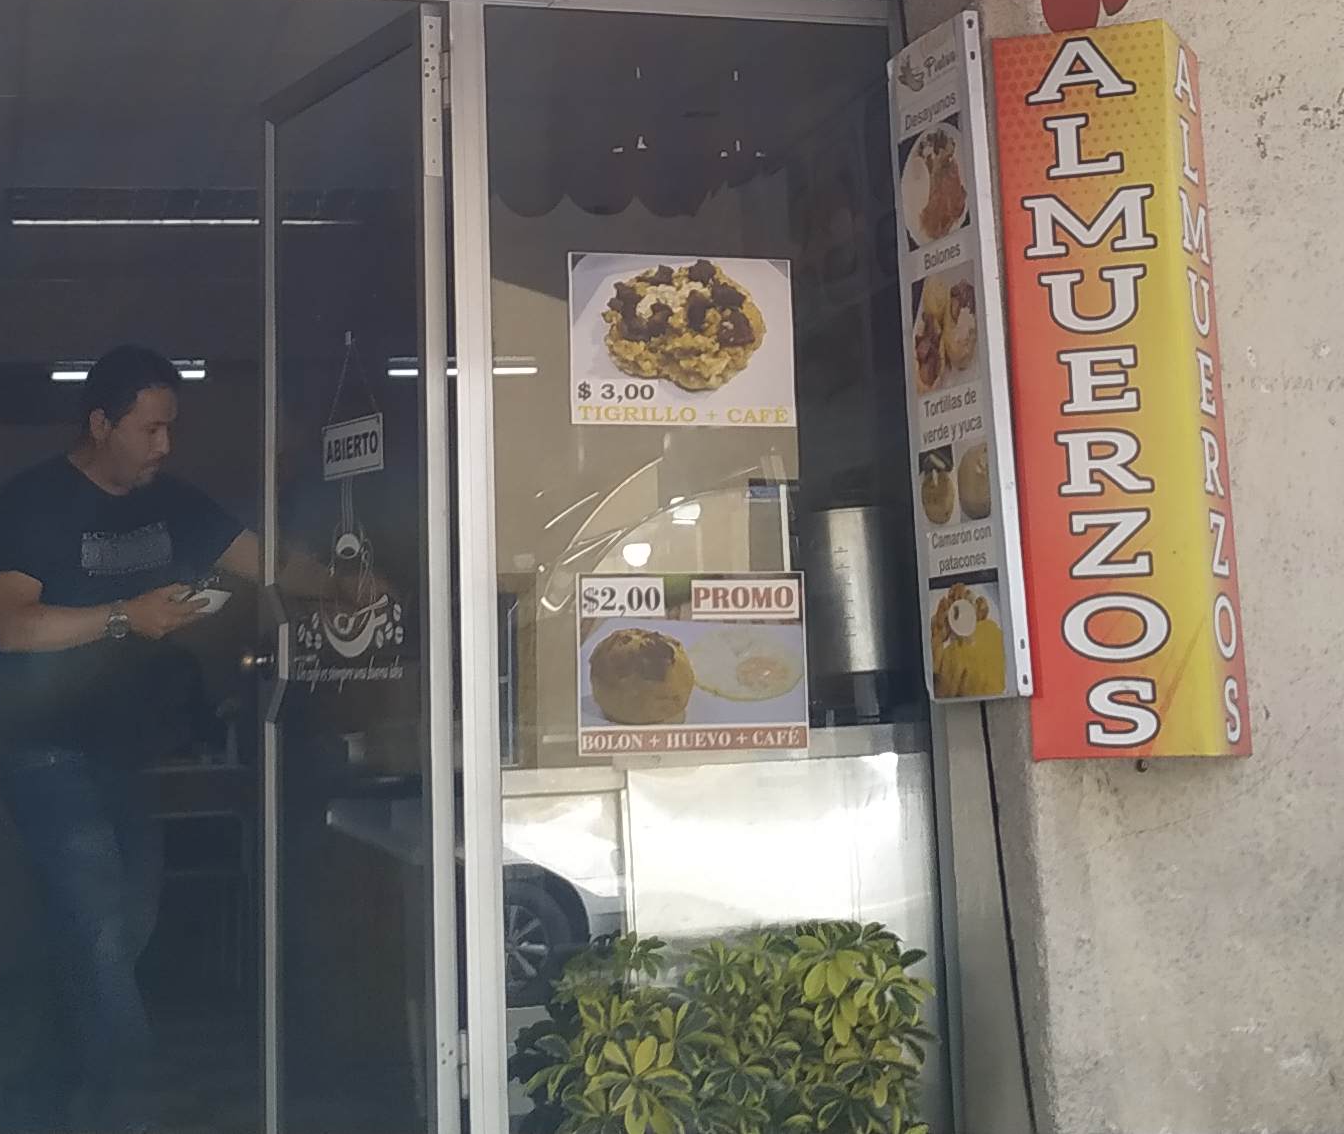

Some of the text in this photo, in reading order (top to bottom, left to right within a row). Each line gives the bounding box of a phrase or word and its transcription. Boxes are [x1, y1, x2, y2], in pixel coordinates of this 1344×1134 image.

[924, 243, 960, 270] Bolones
[577, 381, 654, 403] $ 3,00
[923, 387, 977, 418] Tortillas de
[1023, 37, 1172, 748] ALMUERZOS
[1172, 45, 1243, 745] ALMUERZOS
[578, 405, 697, 422] TIGRILLO
[727, 406, 788, 423] CAFÉ
[923, 422, 950, 445] verde
[958, 415, 982, 439] yuca
[325, 431, 378, 465] ABIERTO
[973, 525, 992, 540] con
[939, 552, 986, 574] patacones
[582, 585, 794, 618] $2,00 PROMO
[582, 732, 643, 750] BOLON
[666, 731, 731, 748] HUEVO
[752, 726, 799, 746] CAFÉ
